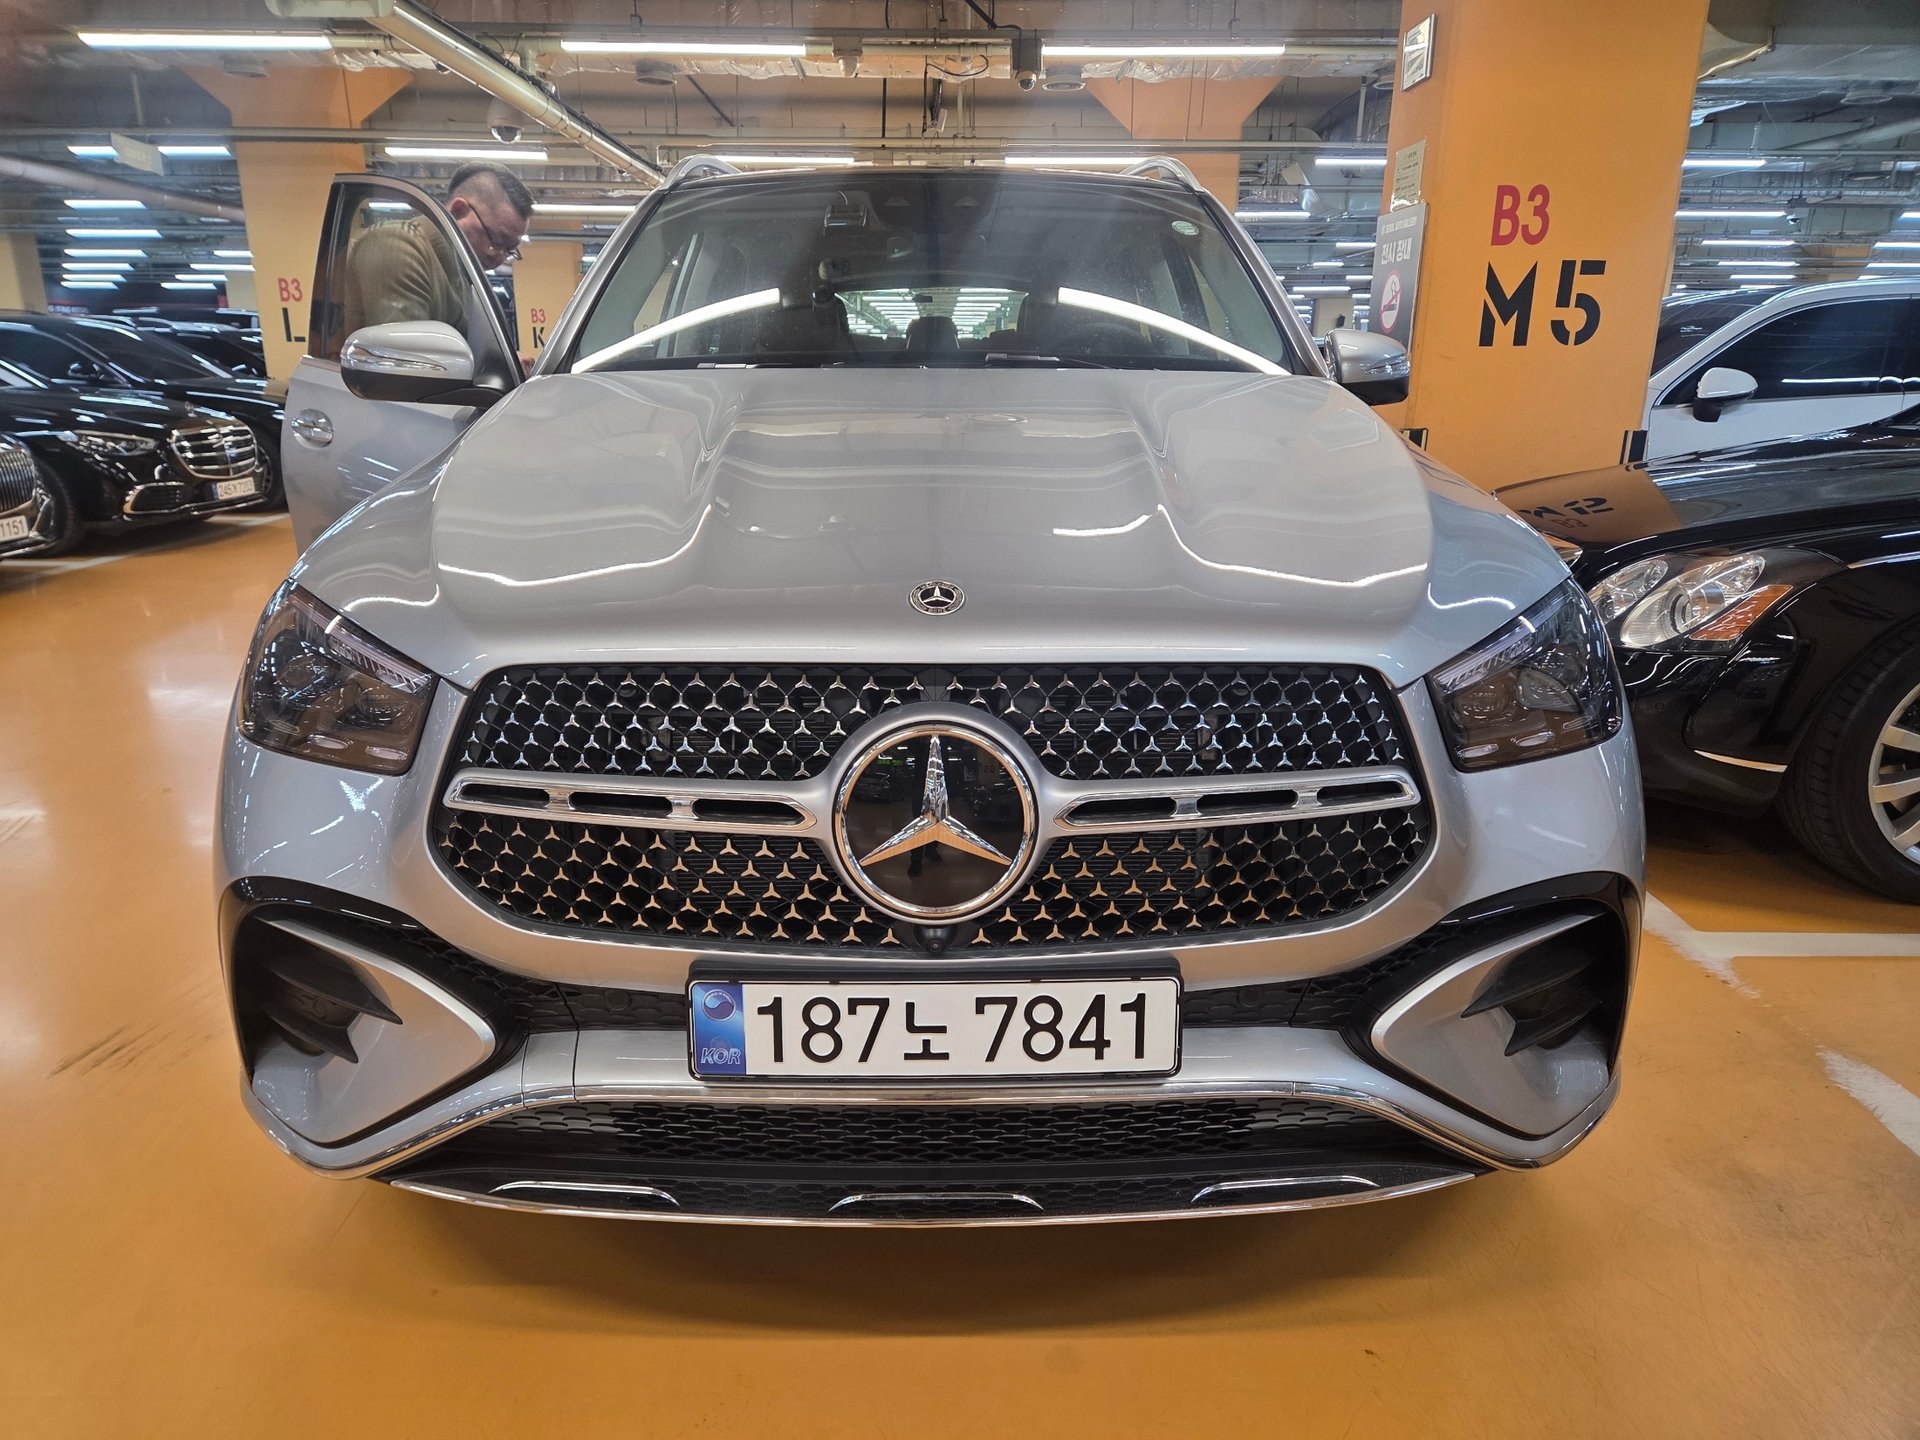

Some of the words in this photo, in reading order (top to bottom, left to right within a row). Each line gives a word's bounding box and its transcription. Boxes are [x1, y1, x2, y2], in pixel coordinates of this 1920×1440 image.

[1491, 184, 1550, 246] B3
[278, 277, 303, 302] B3
[530, 307, 546, 324] B3
[975, 993, 1146, 1063] 7841
[700, 1047, 741, 1064] KOR
